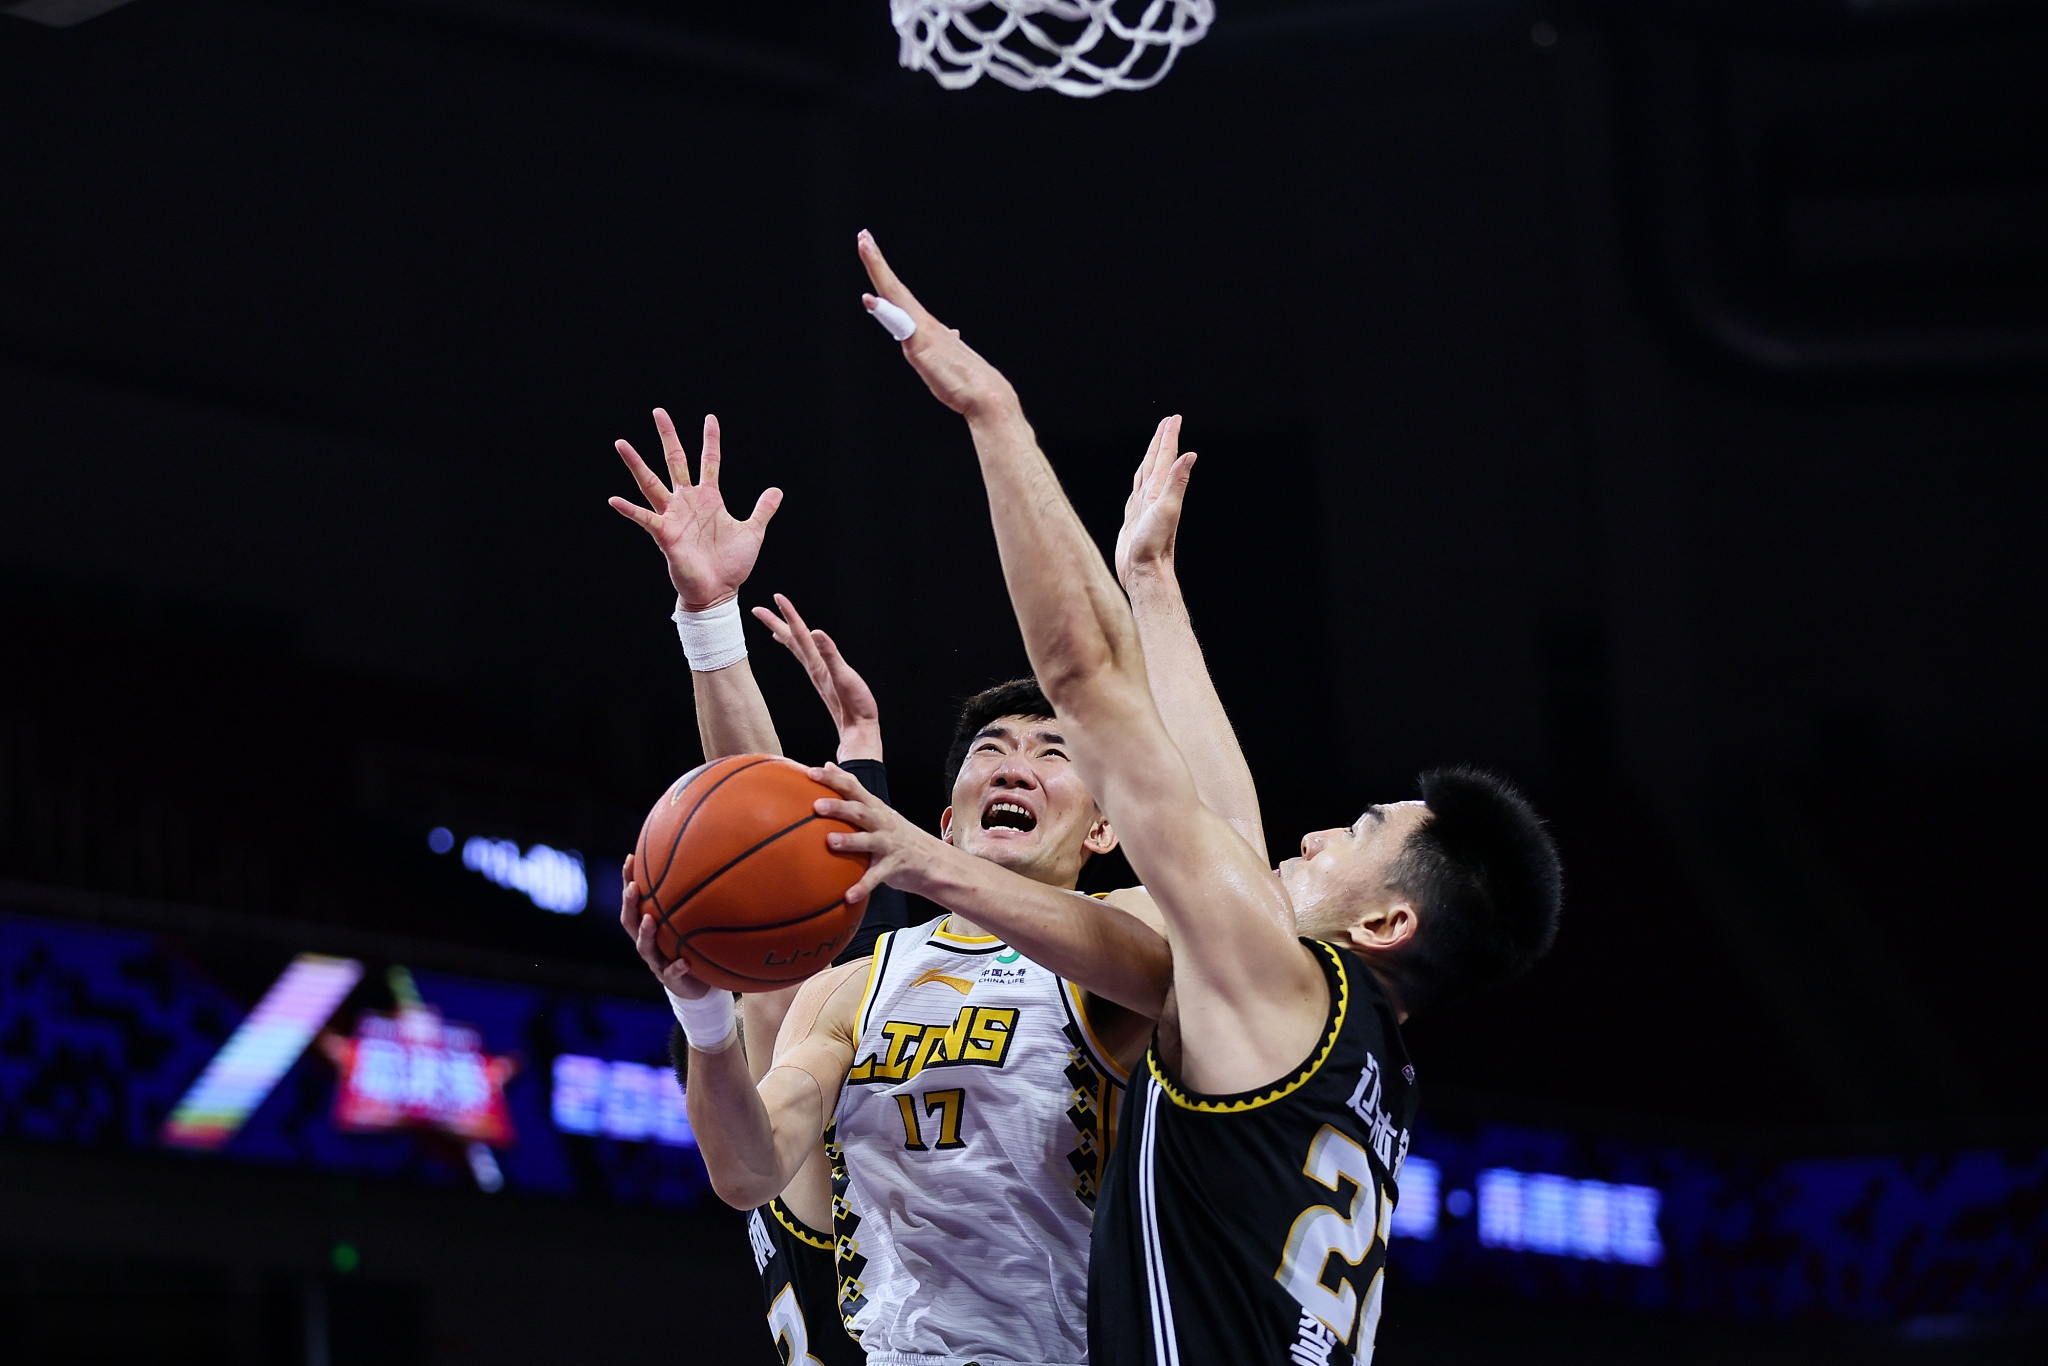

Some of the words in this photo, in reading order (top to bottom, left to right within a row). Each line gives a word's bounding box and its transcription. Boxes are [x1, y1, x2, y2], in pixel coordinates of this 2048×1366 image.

[981, 968, 1027, 977] 中国人寿
[1007, 977, 1026, 985] LIFE
[892, 1087, 968, 1151] 17
